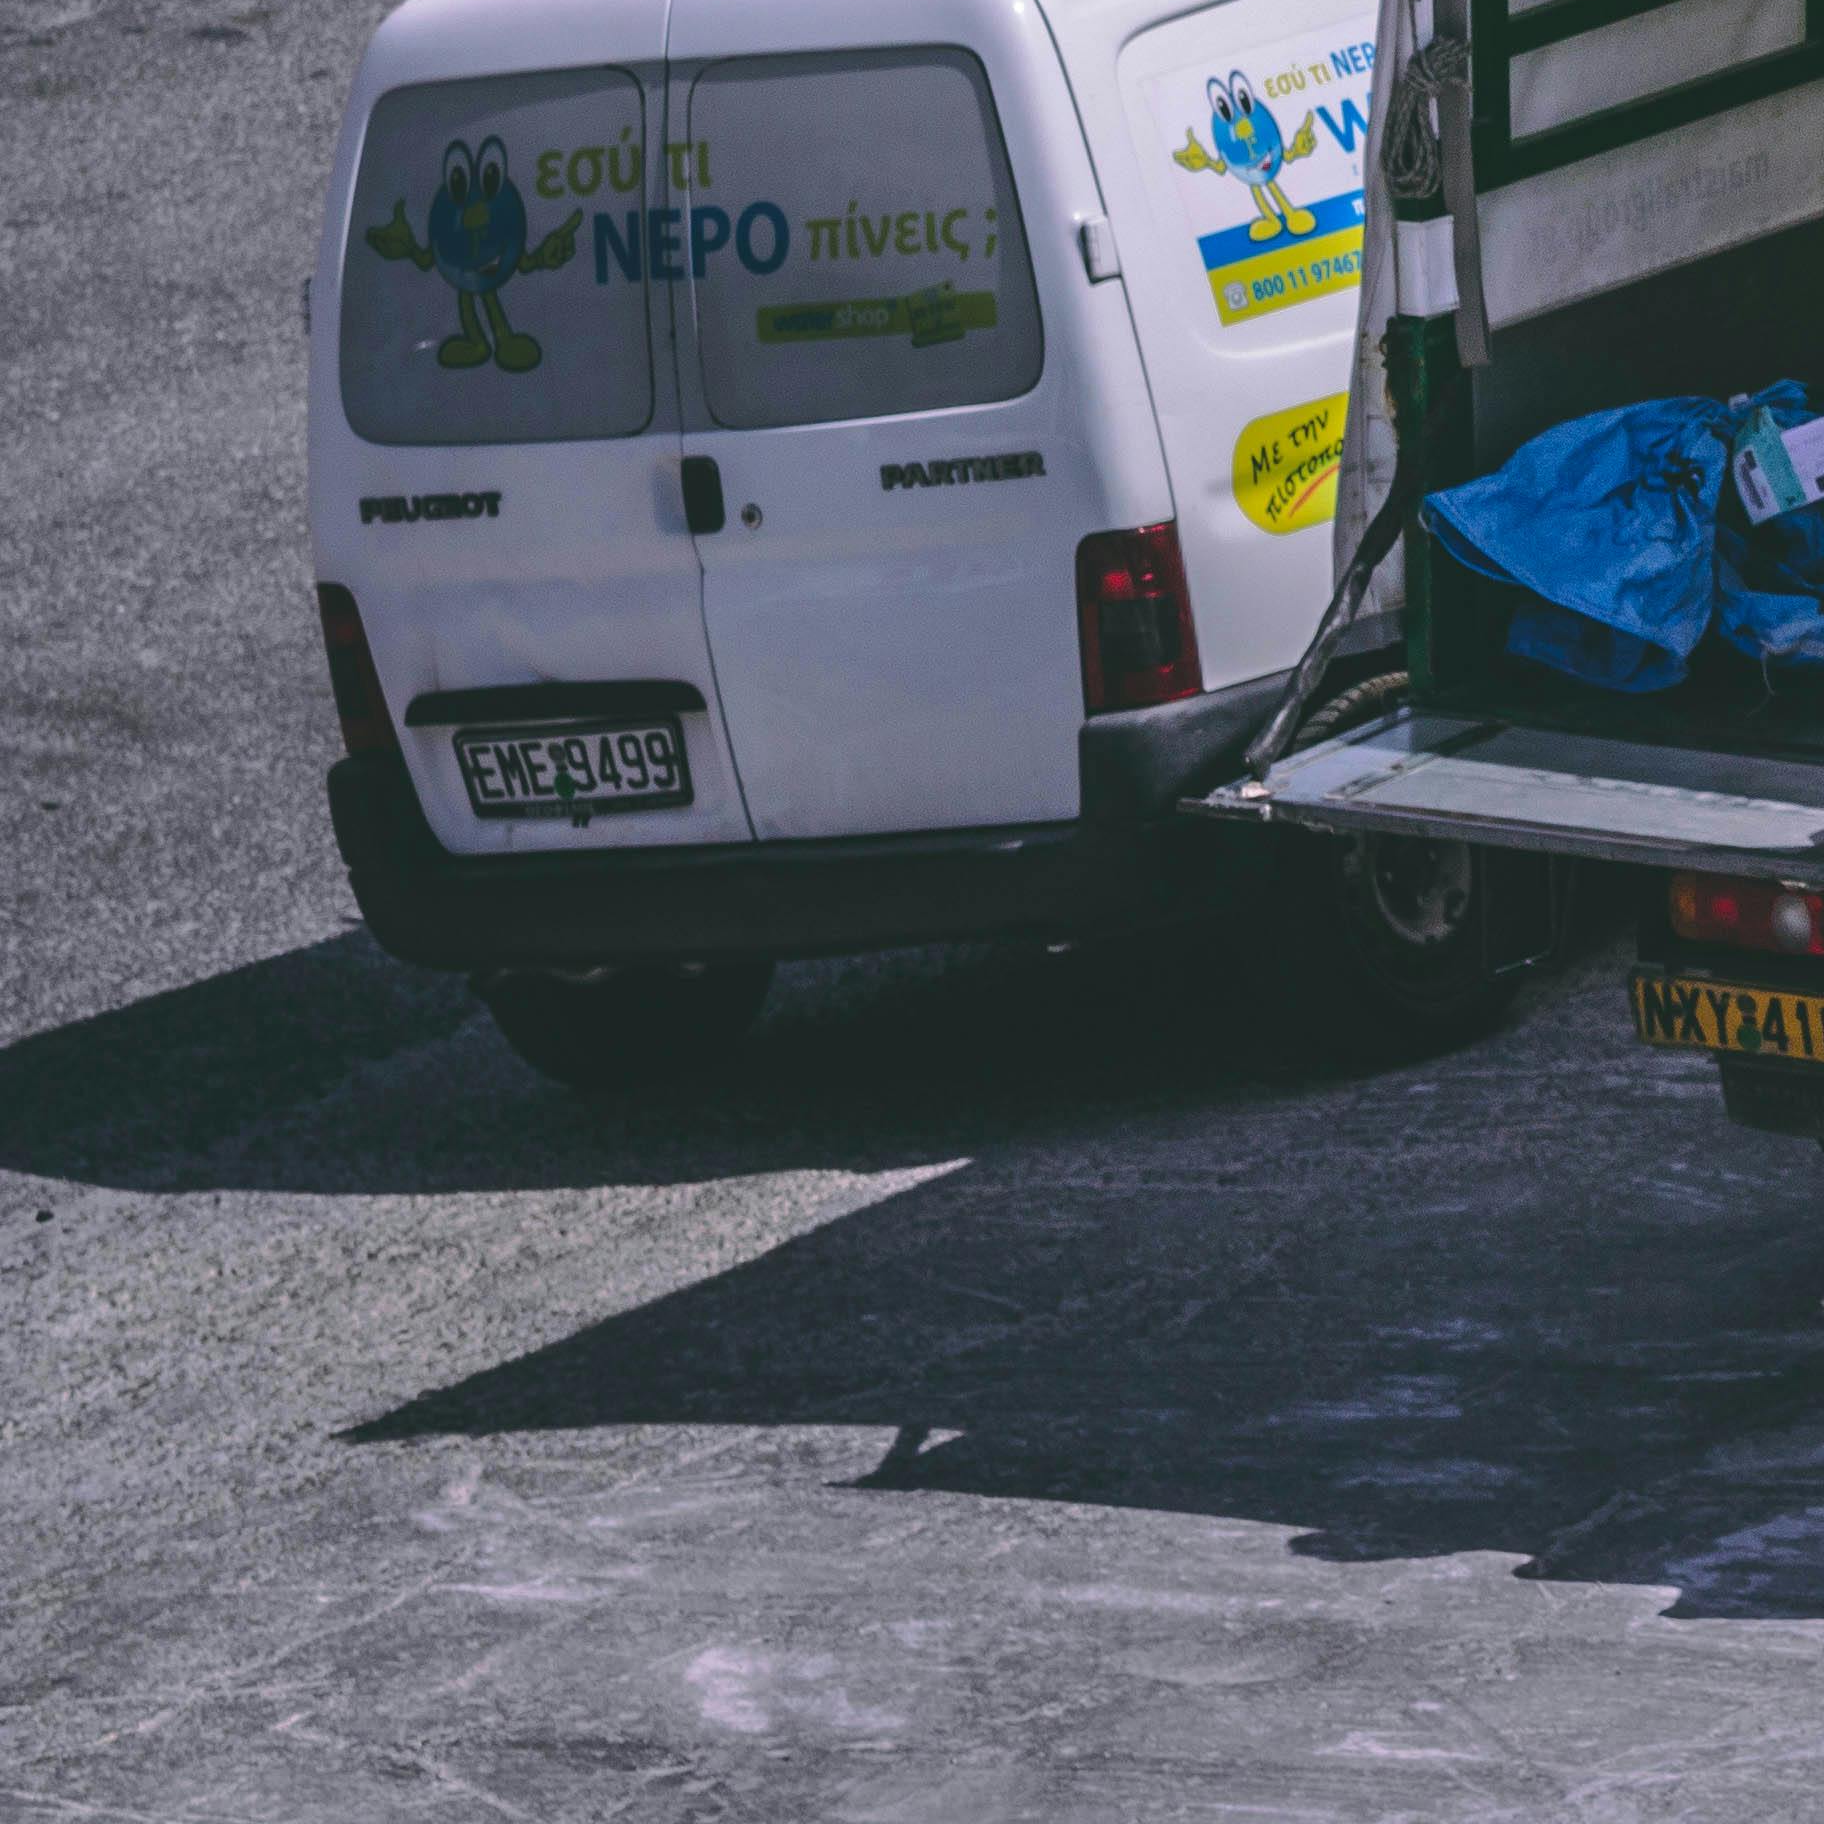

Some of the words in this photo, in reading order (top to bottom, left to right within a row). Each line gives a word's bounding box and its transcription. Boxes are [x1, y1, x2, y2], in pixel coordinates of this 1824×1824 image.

[1263, 64, 1307, 99] εσύ
[1308, 62, 1332, 86] τι
[535, 125, 642, 200] εσύ
[663, 139, 712, 188] τι
[593, 201, 789, 285] ΝΕΡΟ
[1252, 273, 1285, 302] 800
[1287, 265, 1309, 290] 11
[1286, 408, 1330, 448] την
[880, 451, 1046, 491] PARTNER
[359, 491, 502, 524] PEUGEOT
